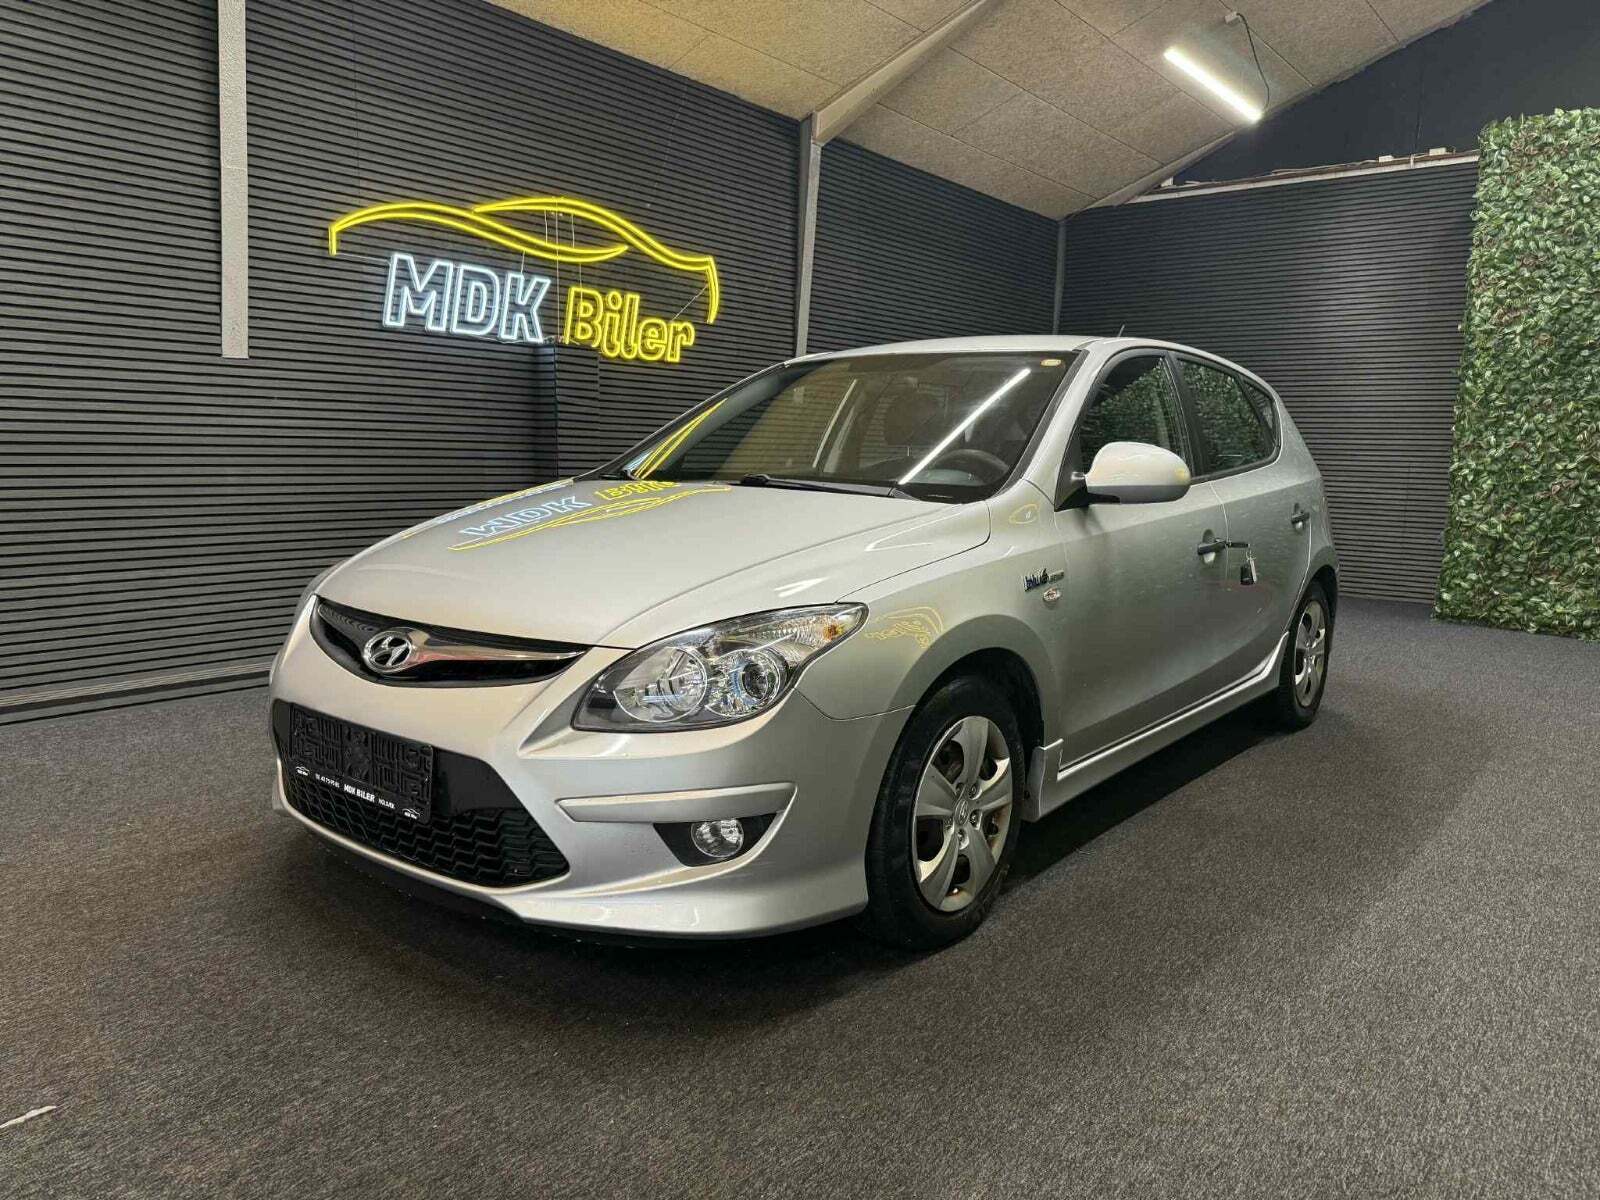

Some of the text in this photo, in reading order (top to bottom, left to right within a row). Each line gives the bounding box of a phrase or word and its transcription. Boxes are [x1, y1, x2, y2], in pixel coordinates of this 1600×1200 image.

[383, 252, 695, 363] MDK Biler
[356, 788, 375, 803] BILER
